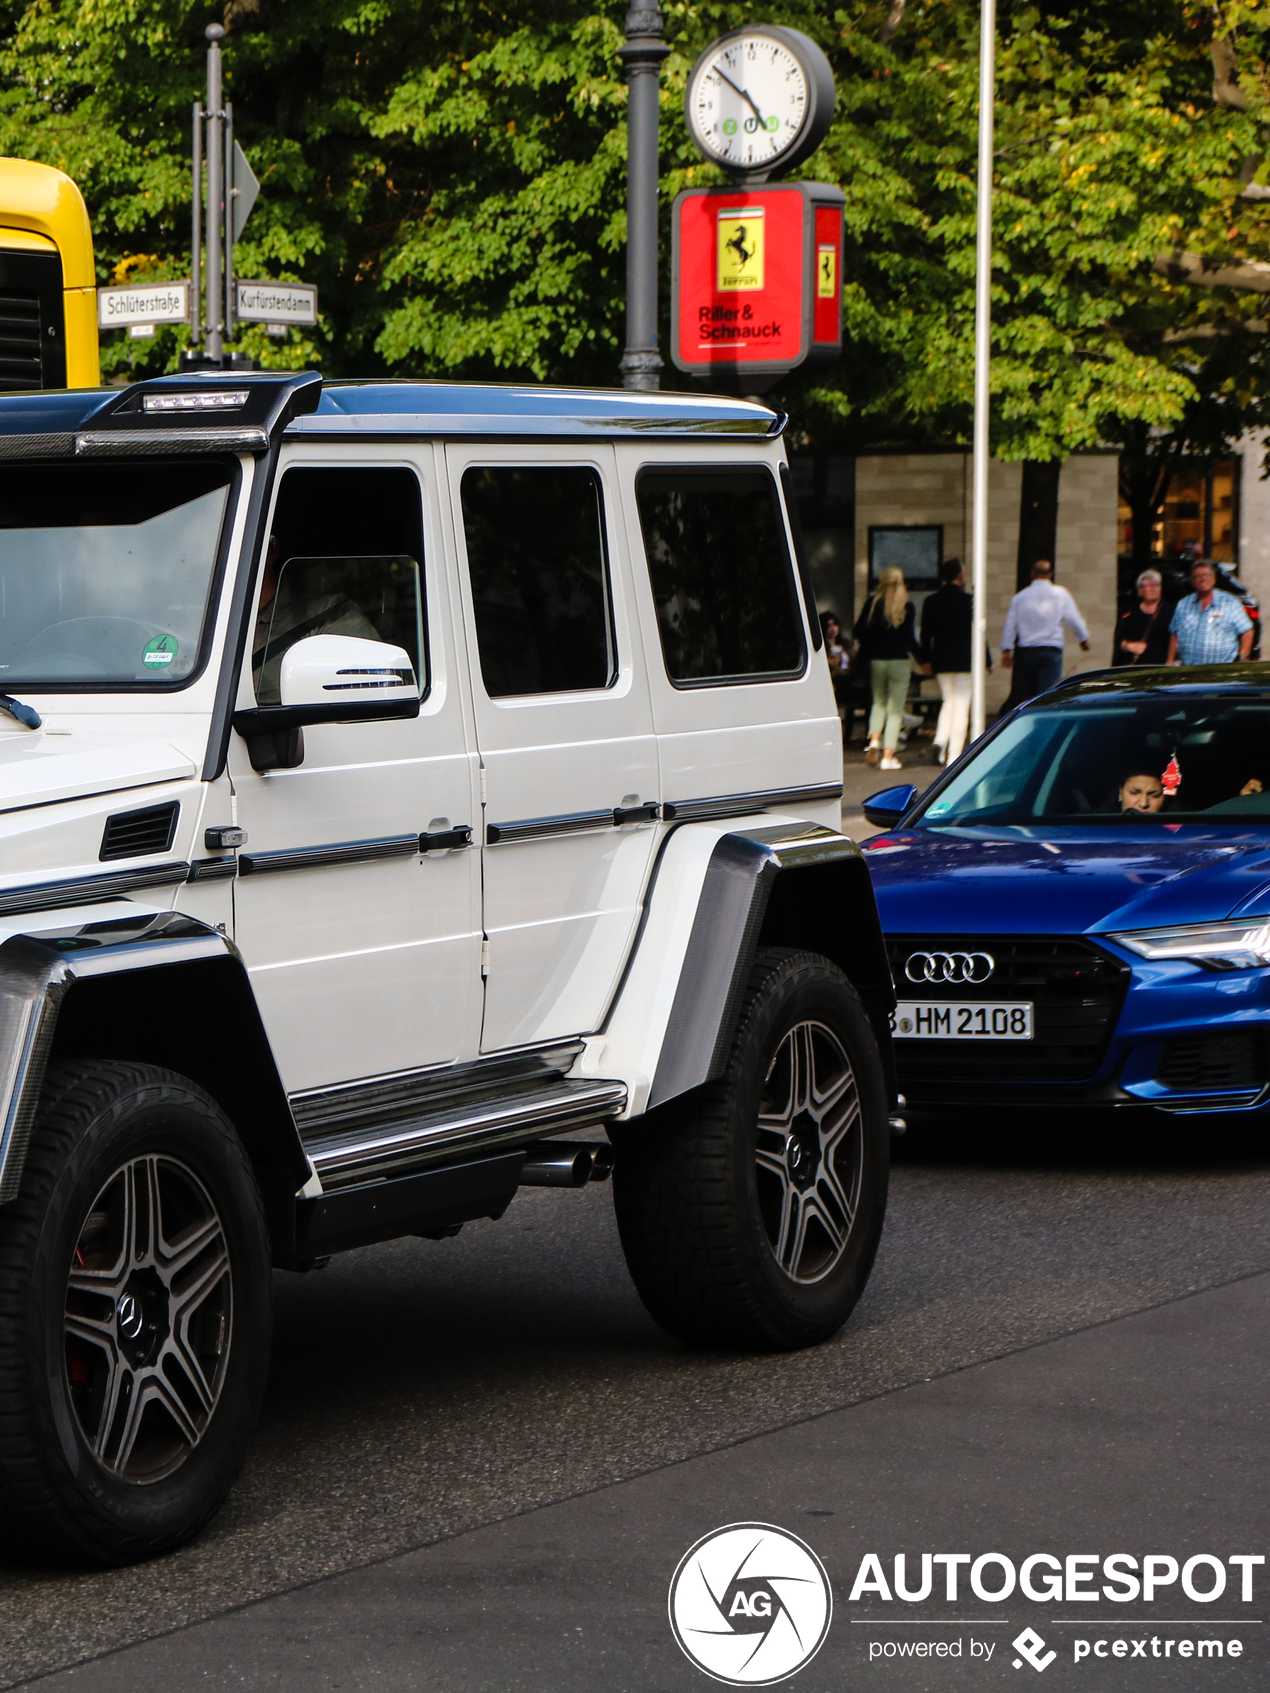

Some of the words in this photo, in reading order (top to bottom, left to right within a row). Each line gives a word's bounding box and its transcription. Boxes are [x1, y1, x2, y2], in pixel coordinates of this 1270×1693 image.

[728, 58, 736, 68] 11
[747, 52, 756, 60] 12
[712, 77, 721, 87] 10
[723, 276, 758, 287] Ferrari
[107, 295, 180, 315] Schlüterstraße
[240, 290, 312, 312] Kurfürstendamm
[699, 305, 740, 322] Riller
[742, 304, 754, 320] &
[699, 322, 782, 340] Schnauck
[156, 636, 168, 652] 4
[915, 1007, 951, 1034] HM
[957, 1008, 1026, 1035] 2108
